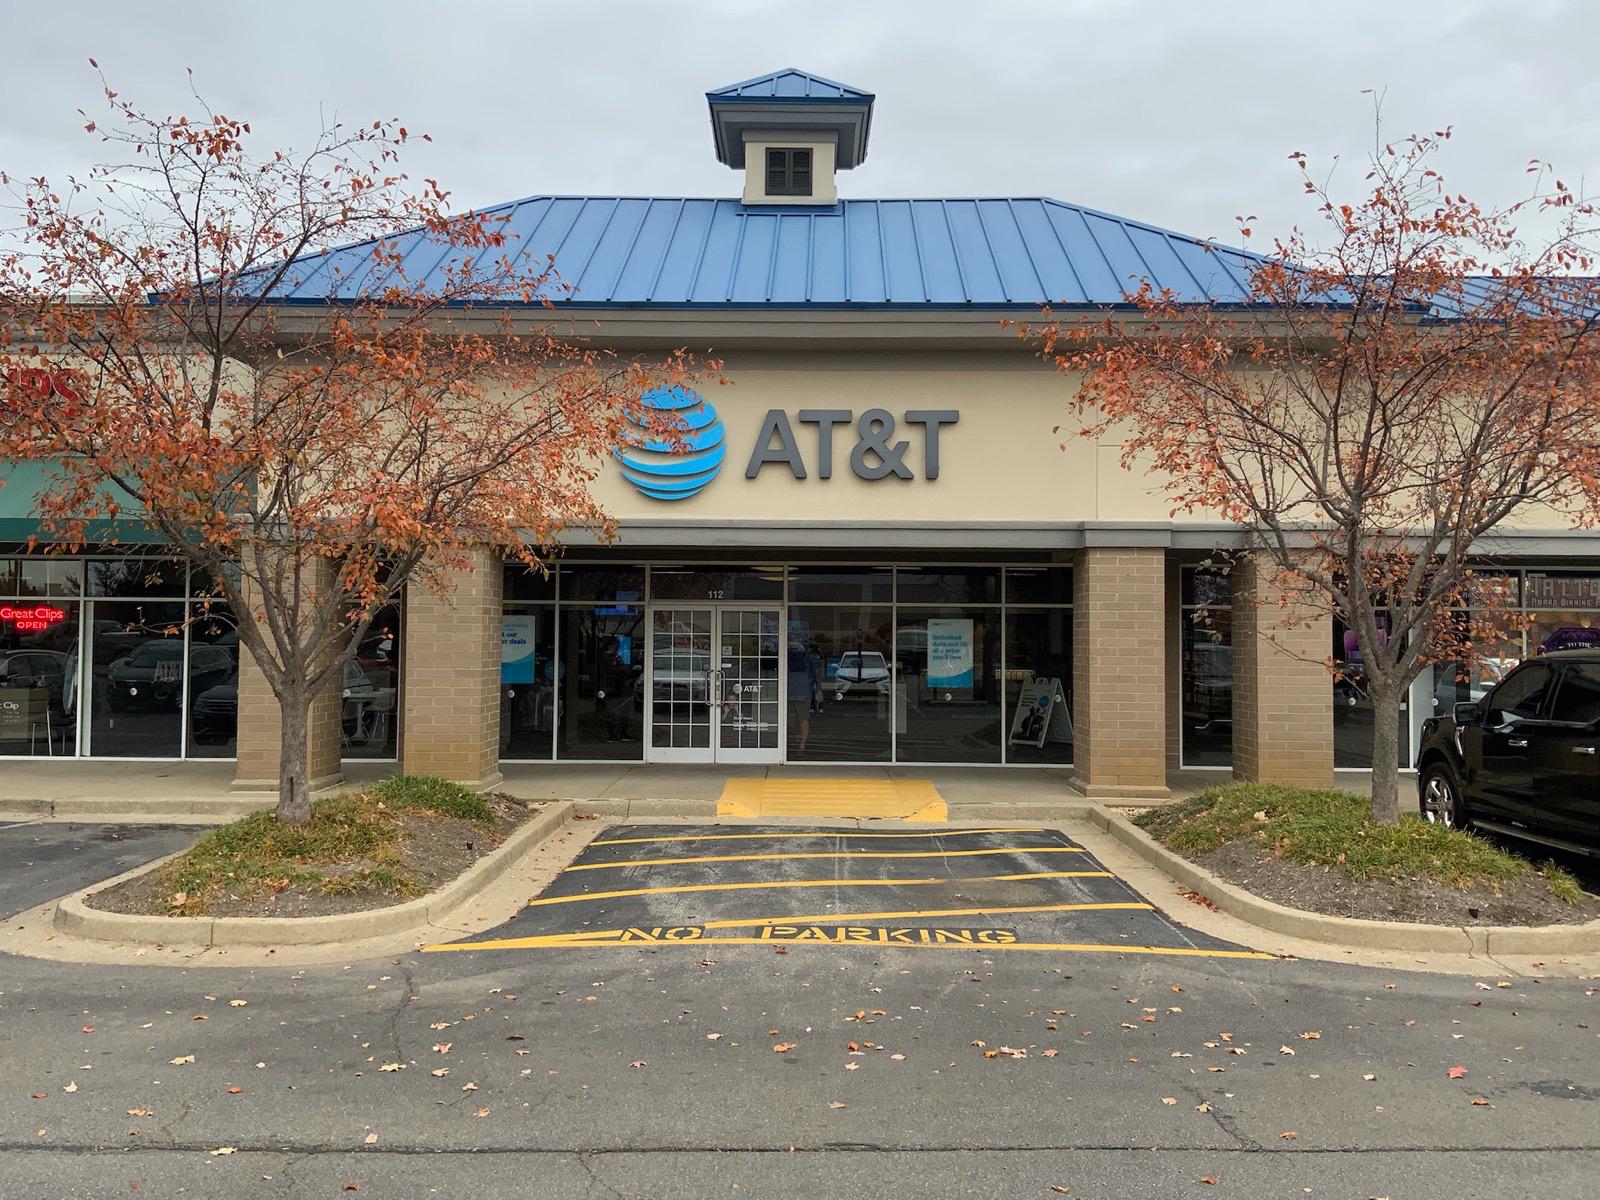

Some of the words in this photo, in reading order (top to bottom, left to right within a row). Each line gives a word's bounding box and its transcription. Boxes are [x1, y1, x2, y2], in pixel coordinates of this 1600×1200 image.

[745, 408, 960, 480] AT&T
[708, 590, 724, 599] 112
[0, 608, 34, 619] Great
[35, 608, 64, 622] Clips
[16, 621, 47, 629] OPEN
[743, 685, 763, 693] AT&T
[620, 926, 703, 942] NO
[760, 926, 1017, 944] PARKING
